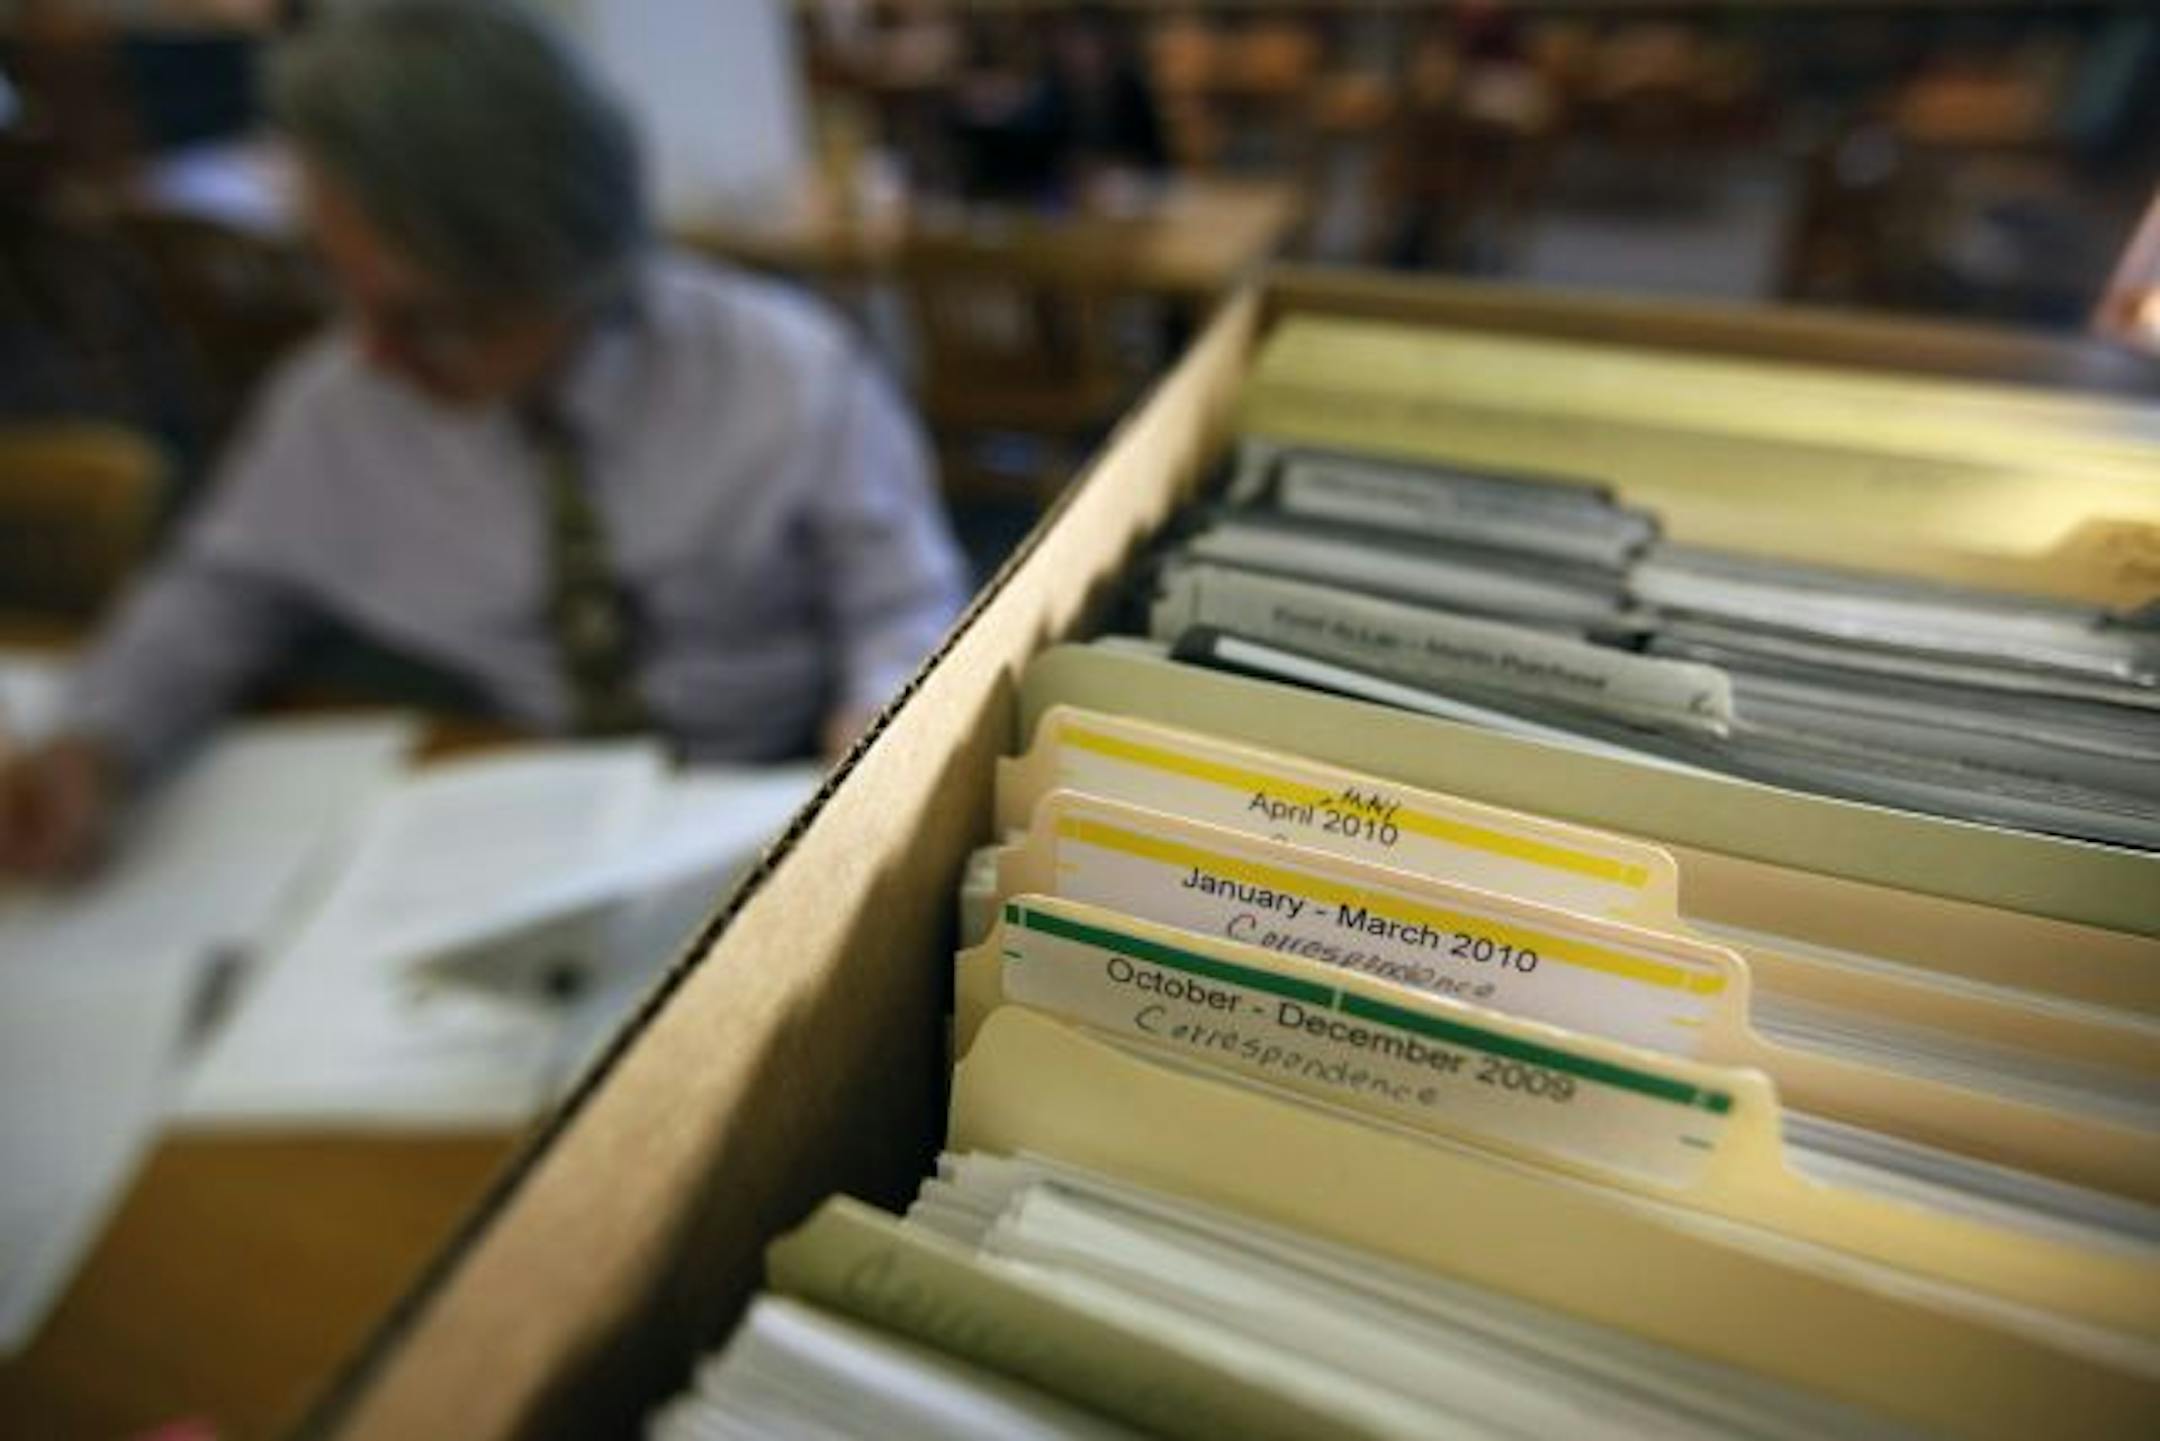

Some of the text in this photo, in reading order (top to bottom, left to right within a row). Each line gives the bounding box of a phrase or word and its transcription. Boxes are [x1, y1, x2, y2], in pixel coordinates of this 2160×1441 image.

[1249, 791, 1398, 846] April 2010
[1182, 867, 1304, 918] January
[1336, 904, 1439, 949] March
[1451, 932, 1538, 973] 2010
[1107, 957, 1242, 1013] October
[1278, 1002, 1464, 1074] December
[1475, 1057, 1577, 1104] 2009
